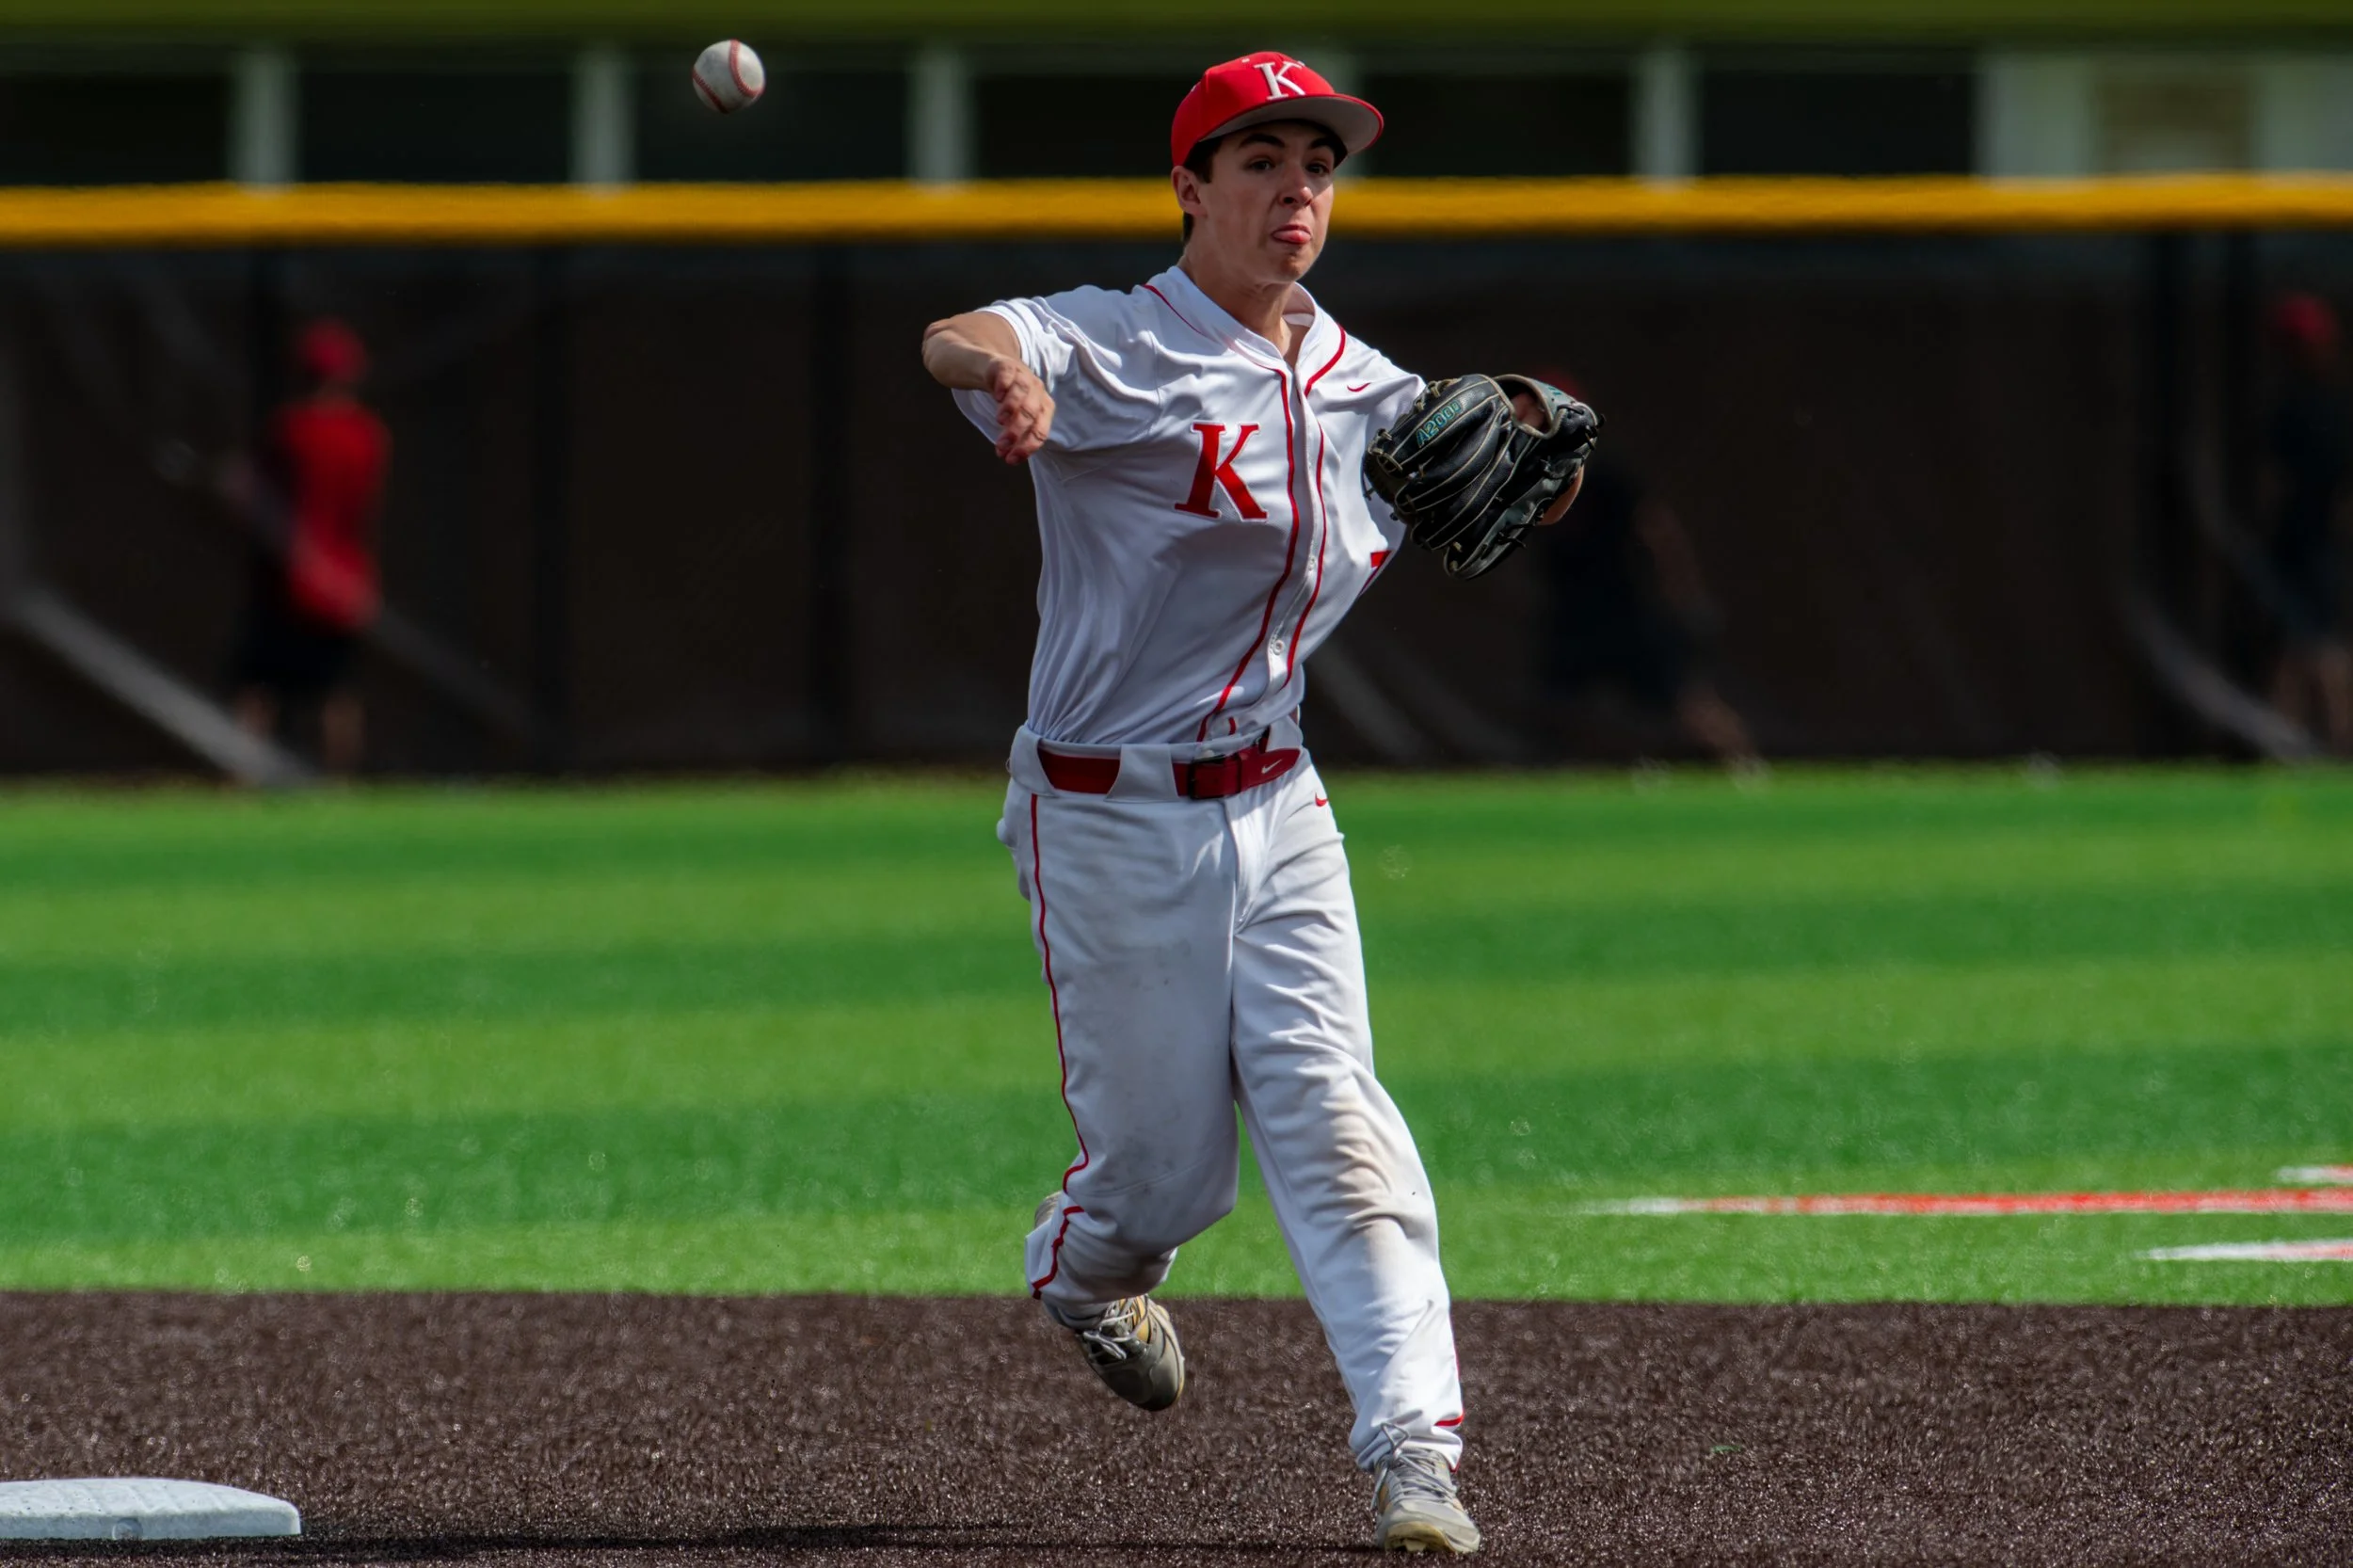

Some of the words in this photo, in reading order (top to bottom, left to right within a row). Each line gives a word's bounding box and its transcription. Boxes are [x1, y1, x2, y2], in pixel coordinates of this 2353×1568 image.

[1254, 61, 1305, 101] K
[1417, 399, 1462, 447] A2000
[1175, 422, 1268, 520] K
